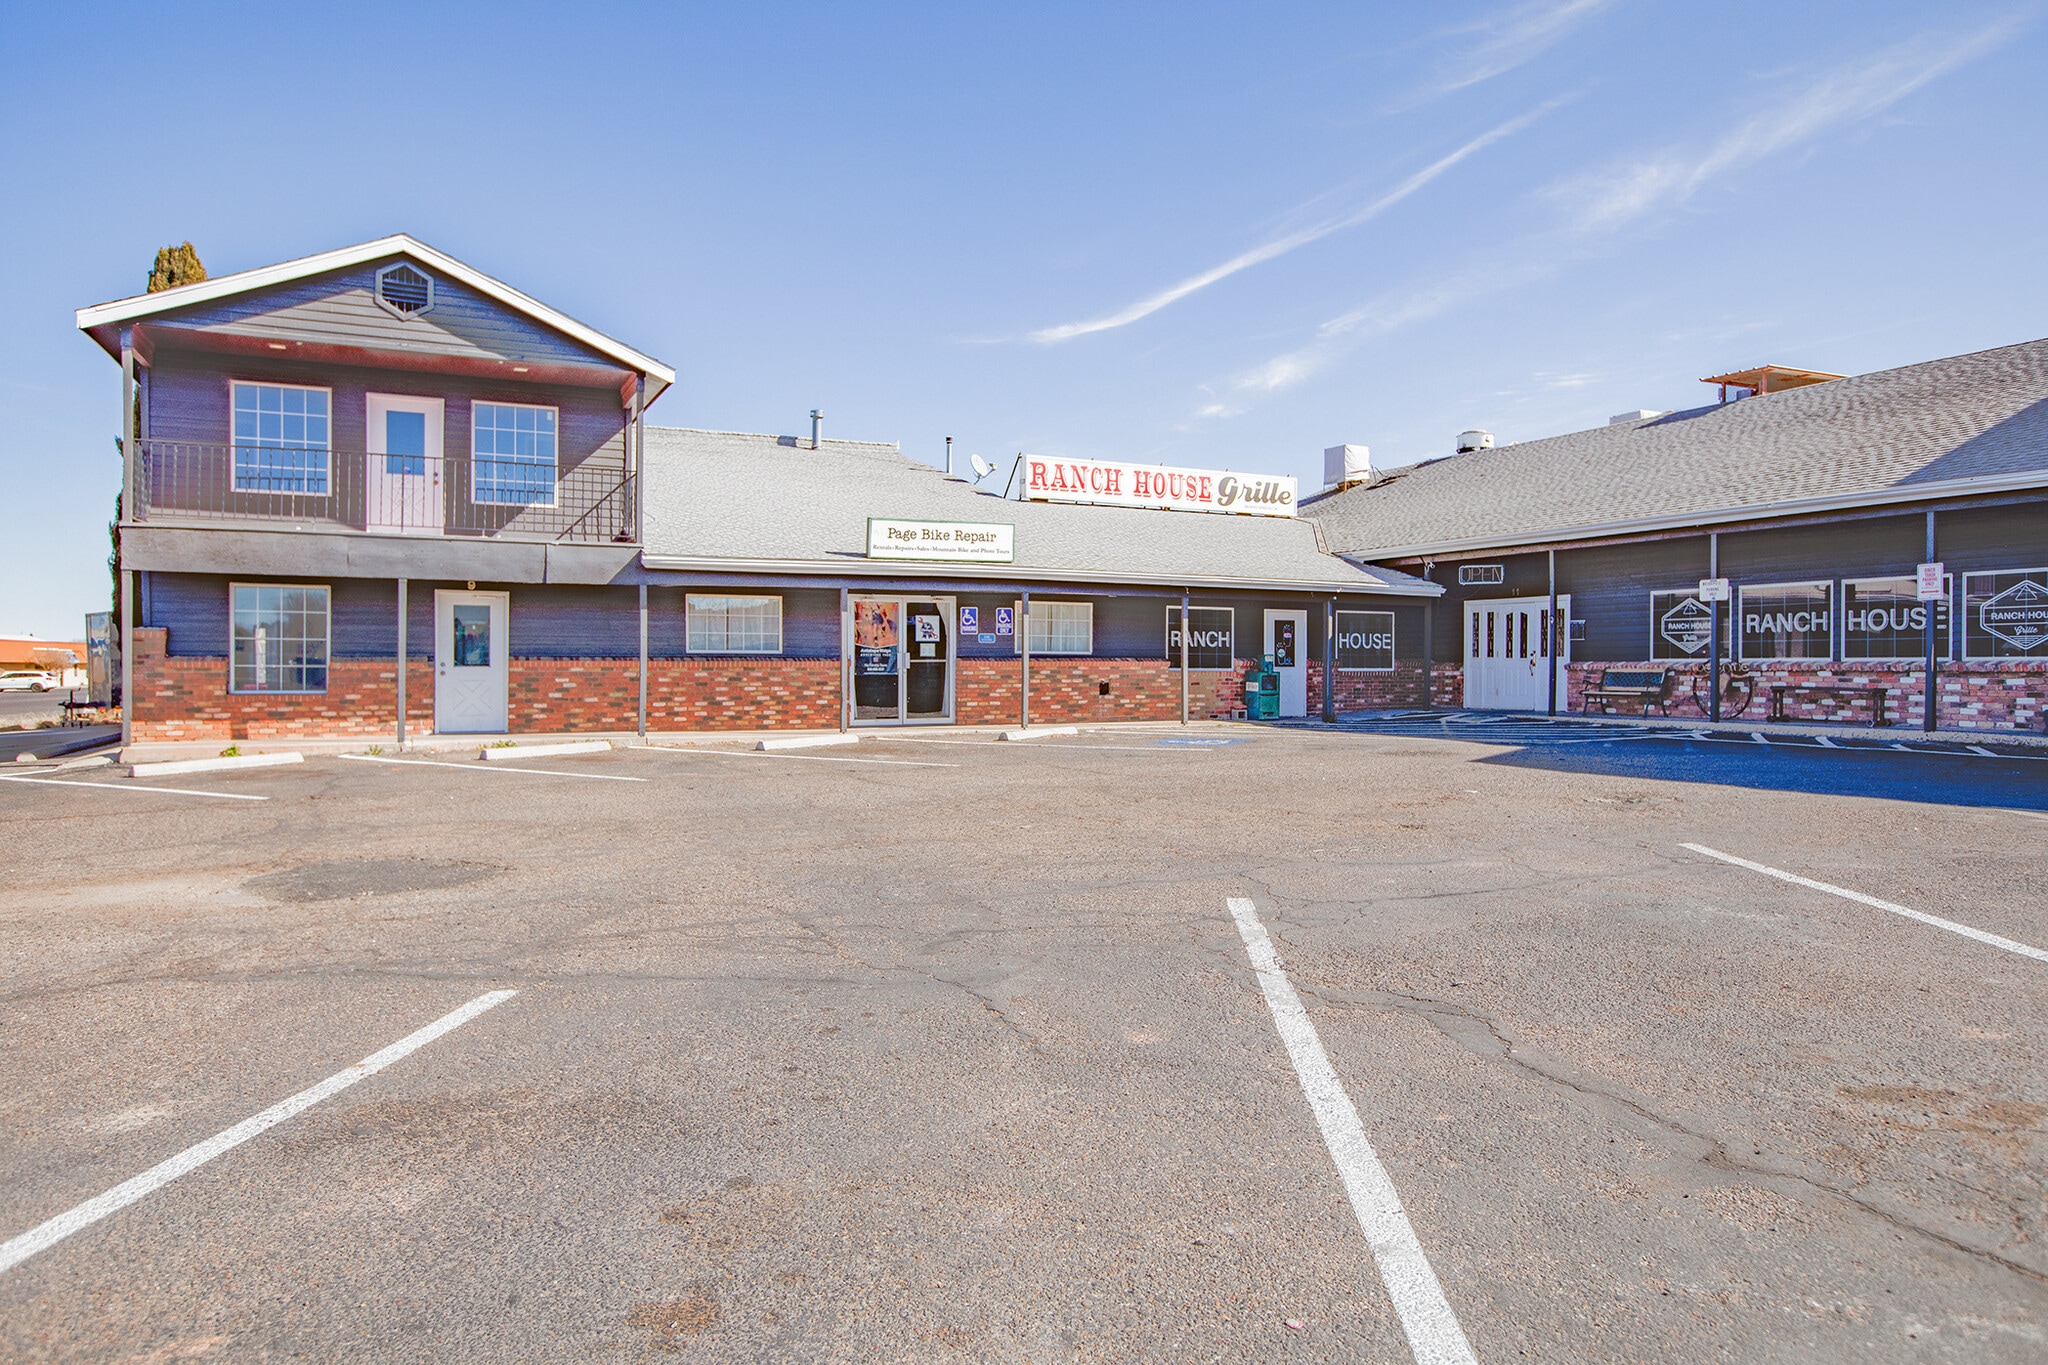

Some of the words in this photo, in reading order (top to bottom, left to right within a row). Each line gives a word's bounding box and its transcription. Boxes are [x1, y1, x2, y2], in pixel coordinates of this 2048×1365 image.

[1029, 461, 1123, 495] RANCH
[1133, 469, 1213, 503] HOUSE
[1217, 476, 1292, 506] Grille
[887, 527, 917, 542] Page
[921, 528, 950, 541] Bike
[954, 530, 997, 544] Repair
[1461, 567, 1502, 582] OPEN
[467, 580, 476, 590] 9
[1512, 588, 1520, 596] 11
[1746, 610, 1828, 633] RANCH
[1991, 611, 2025, 620] RANCH
[1668, 622, 1690, 630] RANCH
[2014, 625, 2039, 636] Grille
[1339, 632, 1392, 649] HOUSE
